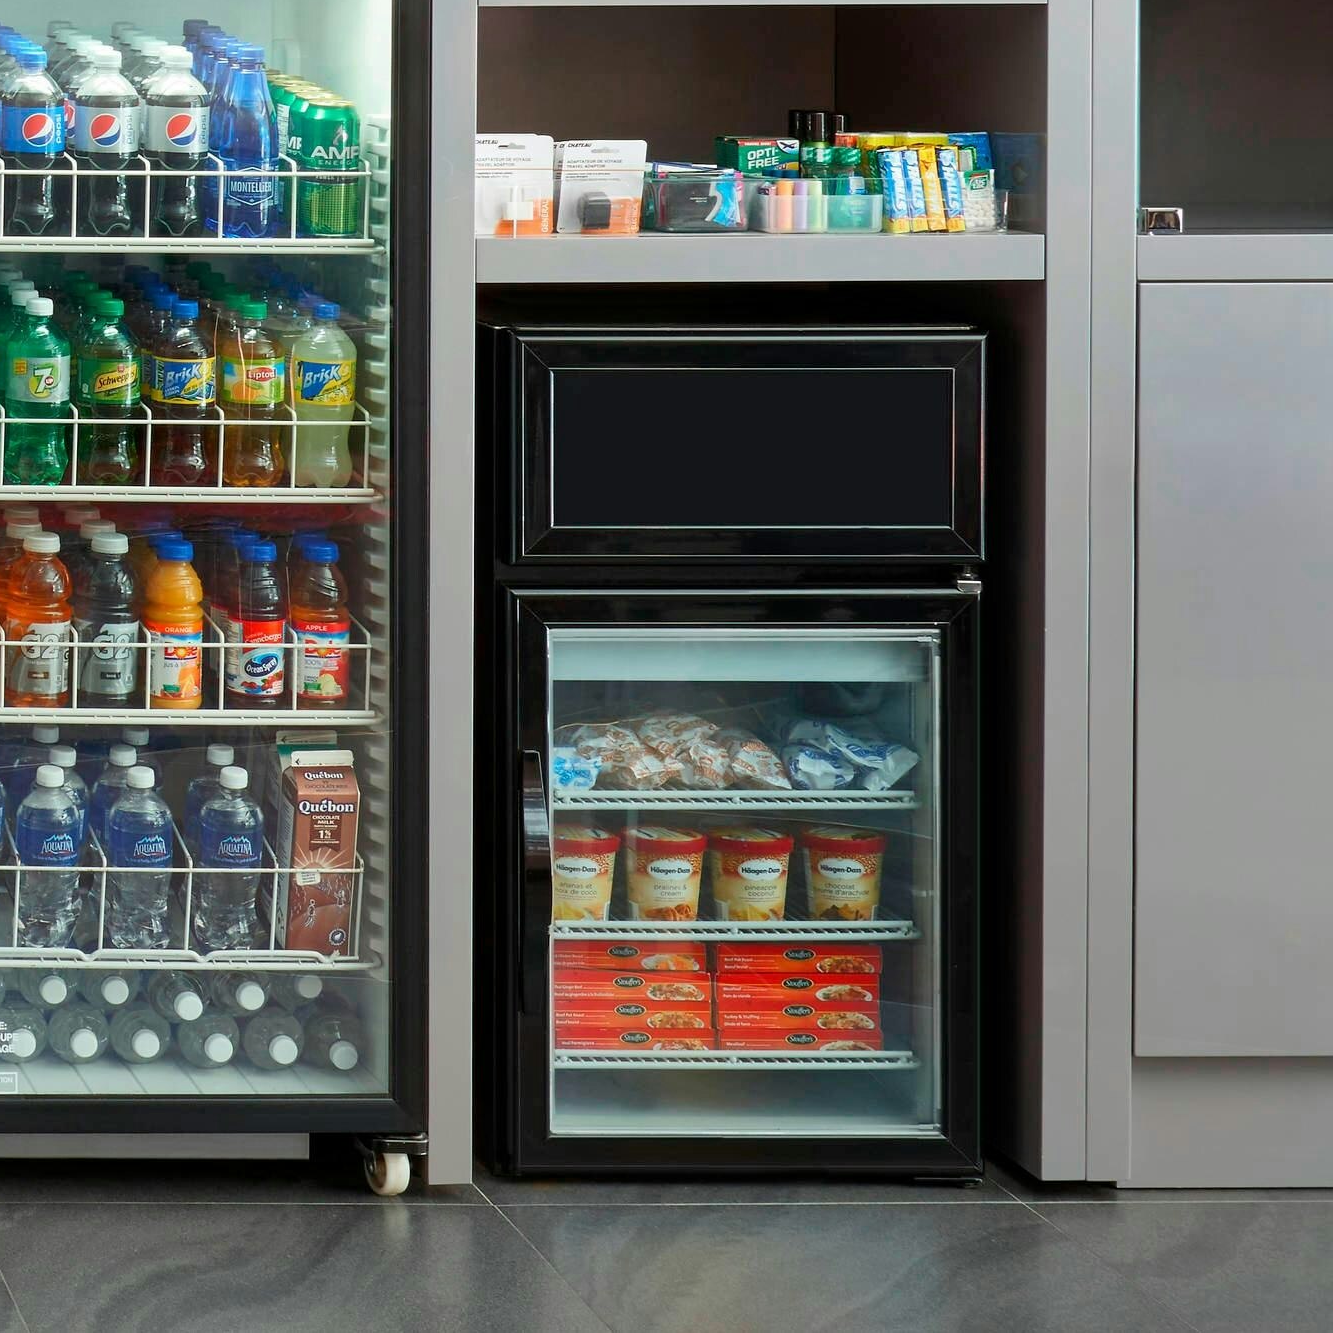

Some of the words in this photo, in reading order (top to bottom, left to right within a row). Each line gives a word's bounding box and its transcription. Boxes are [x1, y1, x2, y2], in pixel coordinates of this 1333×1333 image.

[311, 146, 359, 159] AMP
[747, 146, 779, 161] OPTI-
[748, 156, 779, 170] FREE
[304, 364, 342, 387] Brisk
[165, 626, 193, 634] ORANGE
[21, 633, 61, 659] G2
[93, 634, 131, 660] G2
[245, 663, 265, 675] Ocean
[263, 657, 279, 673] Spray
[304, 771, 344, 780] Québon
[299, 799, 354, 815] Québon
